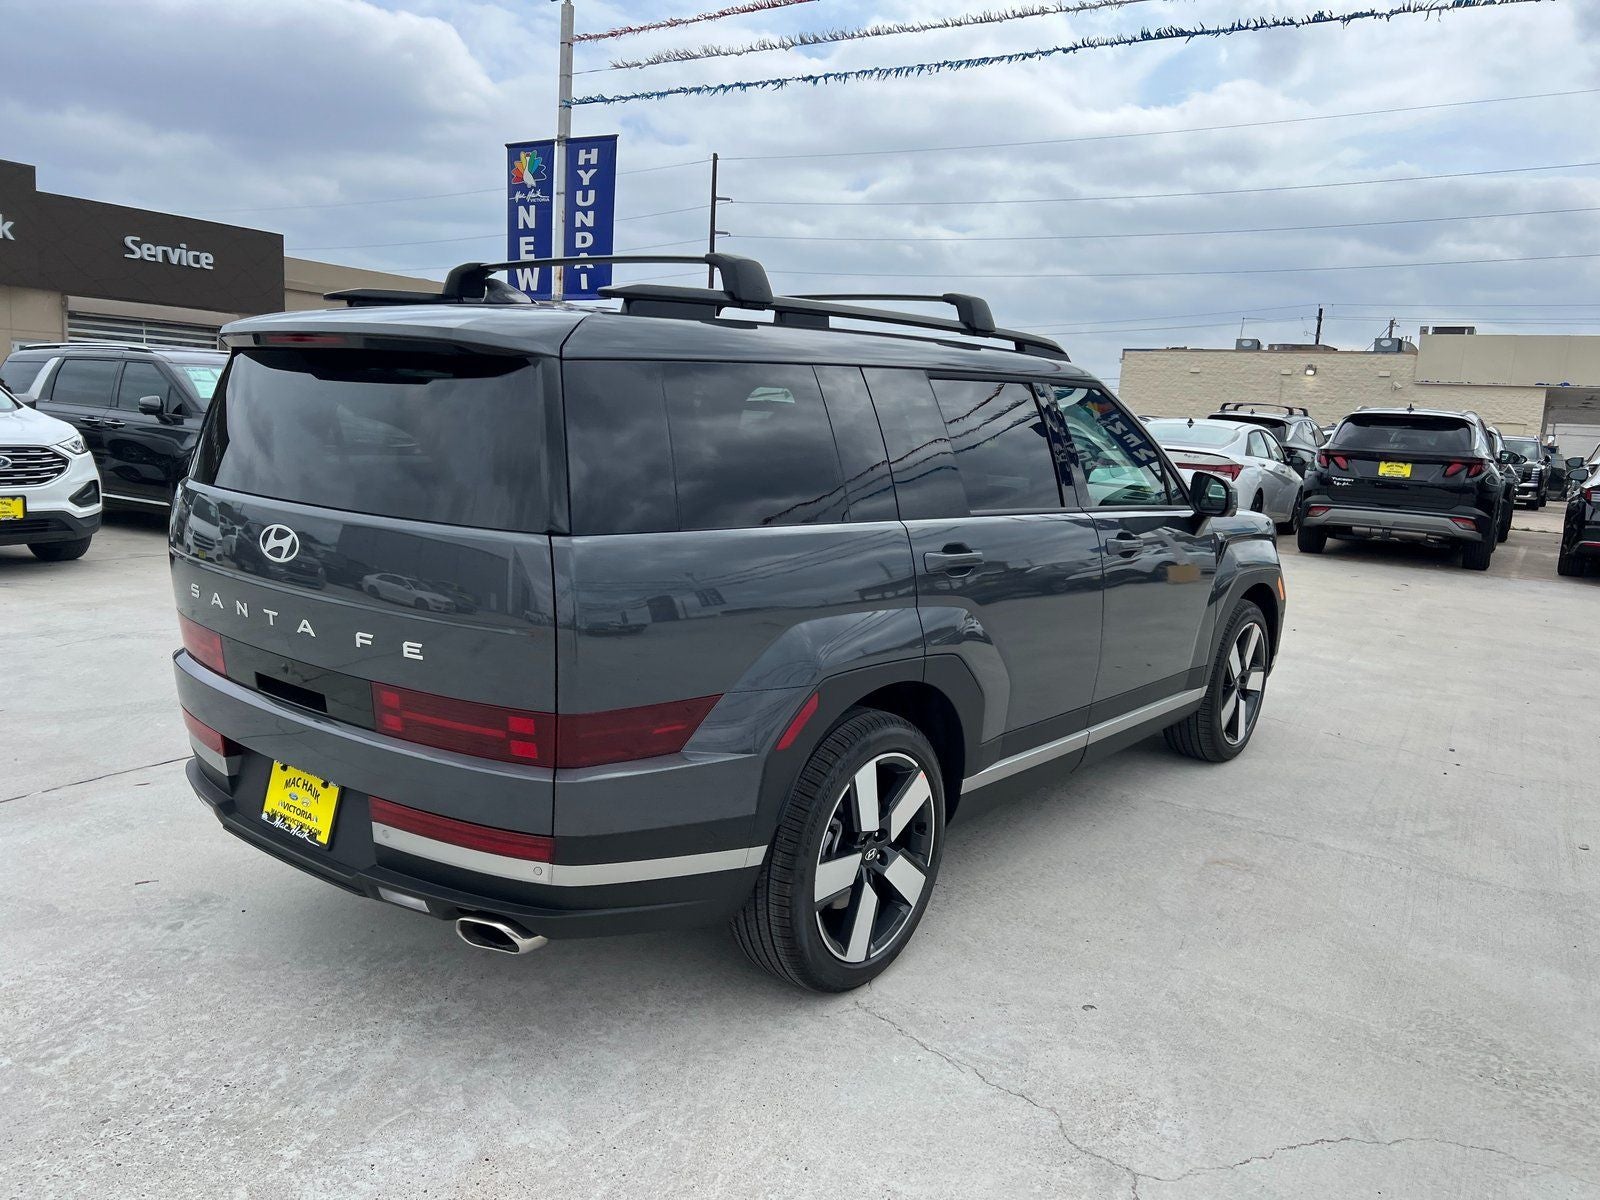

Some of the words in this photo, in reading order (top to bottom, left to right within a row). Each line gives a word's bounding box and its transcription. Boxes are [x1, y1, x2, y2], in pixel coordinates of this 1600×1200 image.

[123, 235, 214, 270] Service
[516, 204, 540, 291] NEW
[190, 583, 316, 638] SANTA
[355, 631, 424, 660] FE
[284, 777, 302, 790] MAC
[302, 780, 320, 804] HAIK
[283, 801, 312, 822] VICTORIA
[268, 817, 291, 832] Mac
[290, 826, 315, 843] Haik
